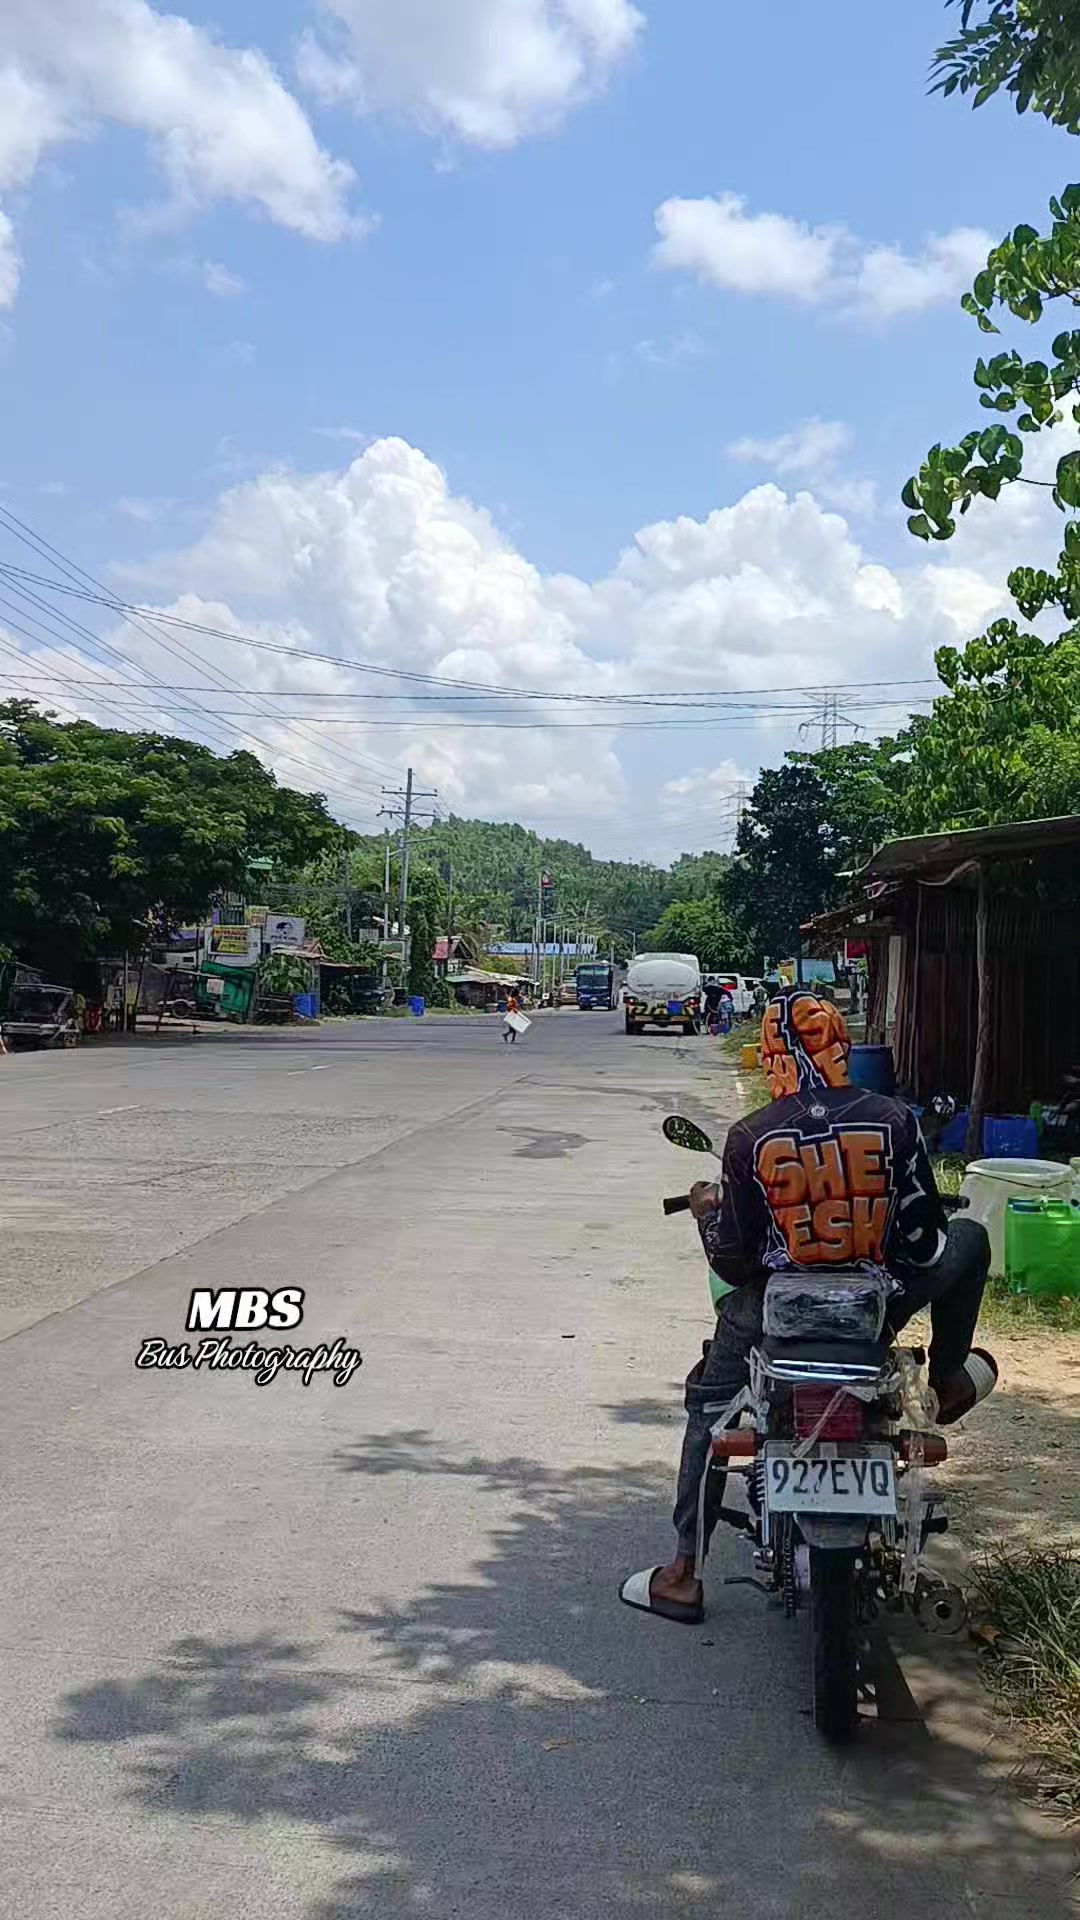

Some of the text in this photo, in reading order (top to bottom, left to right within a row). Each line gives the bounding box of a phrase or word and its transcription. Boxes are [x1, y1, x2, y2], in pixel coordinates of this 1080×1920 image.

[756, 1131, 888, 1206] SHE
[781, 1196, 889, 1264] ESH
[772, 1459, 890, 1497] 927EYQ
